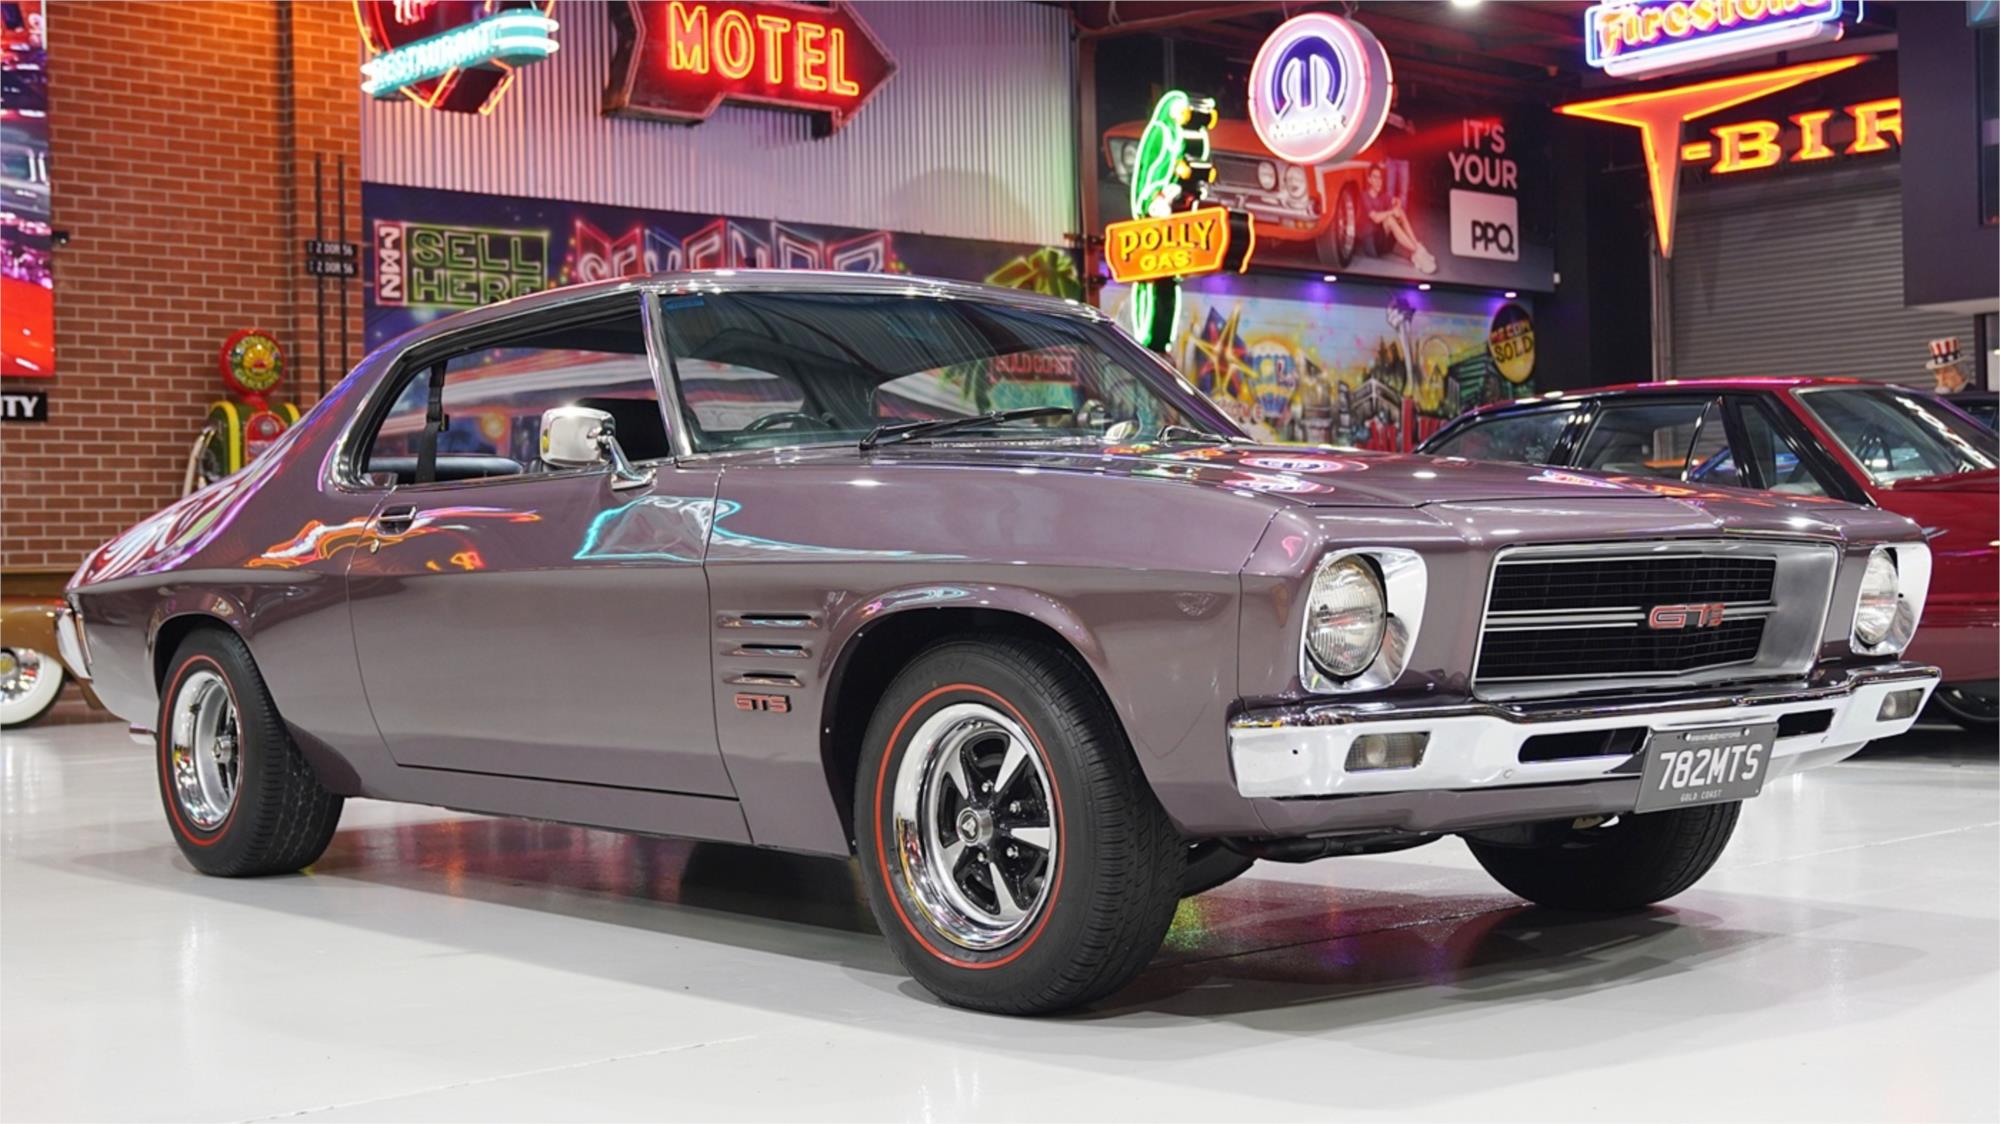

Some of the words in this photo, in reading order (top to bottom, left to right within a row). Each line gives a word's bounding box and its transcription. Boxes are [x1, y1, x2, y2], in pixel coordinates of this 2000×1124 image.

[1600, 0, 1824, 57] Firesto
[668, 1, 859, 96] MOTEL
[1463, 119, 1506, 153] IT'S
[1448, 151, 1518, 190] YOUR
[412, 229, 542, 273] SELL
[1119, 218, 1216, 262] POLLY
[1471, 219, 1514, 255] PPQ
[1140, 250, 1191, 272] GAS
[1494, 334, 1533, 364] SOLD
[734, 691, 791, 713] GTS
[1658, 743, 1763, 791] 782MTS
[1680, 791, 1698, 802] GOLD
